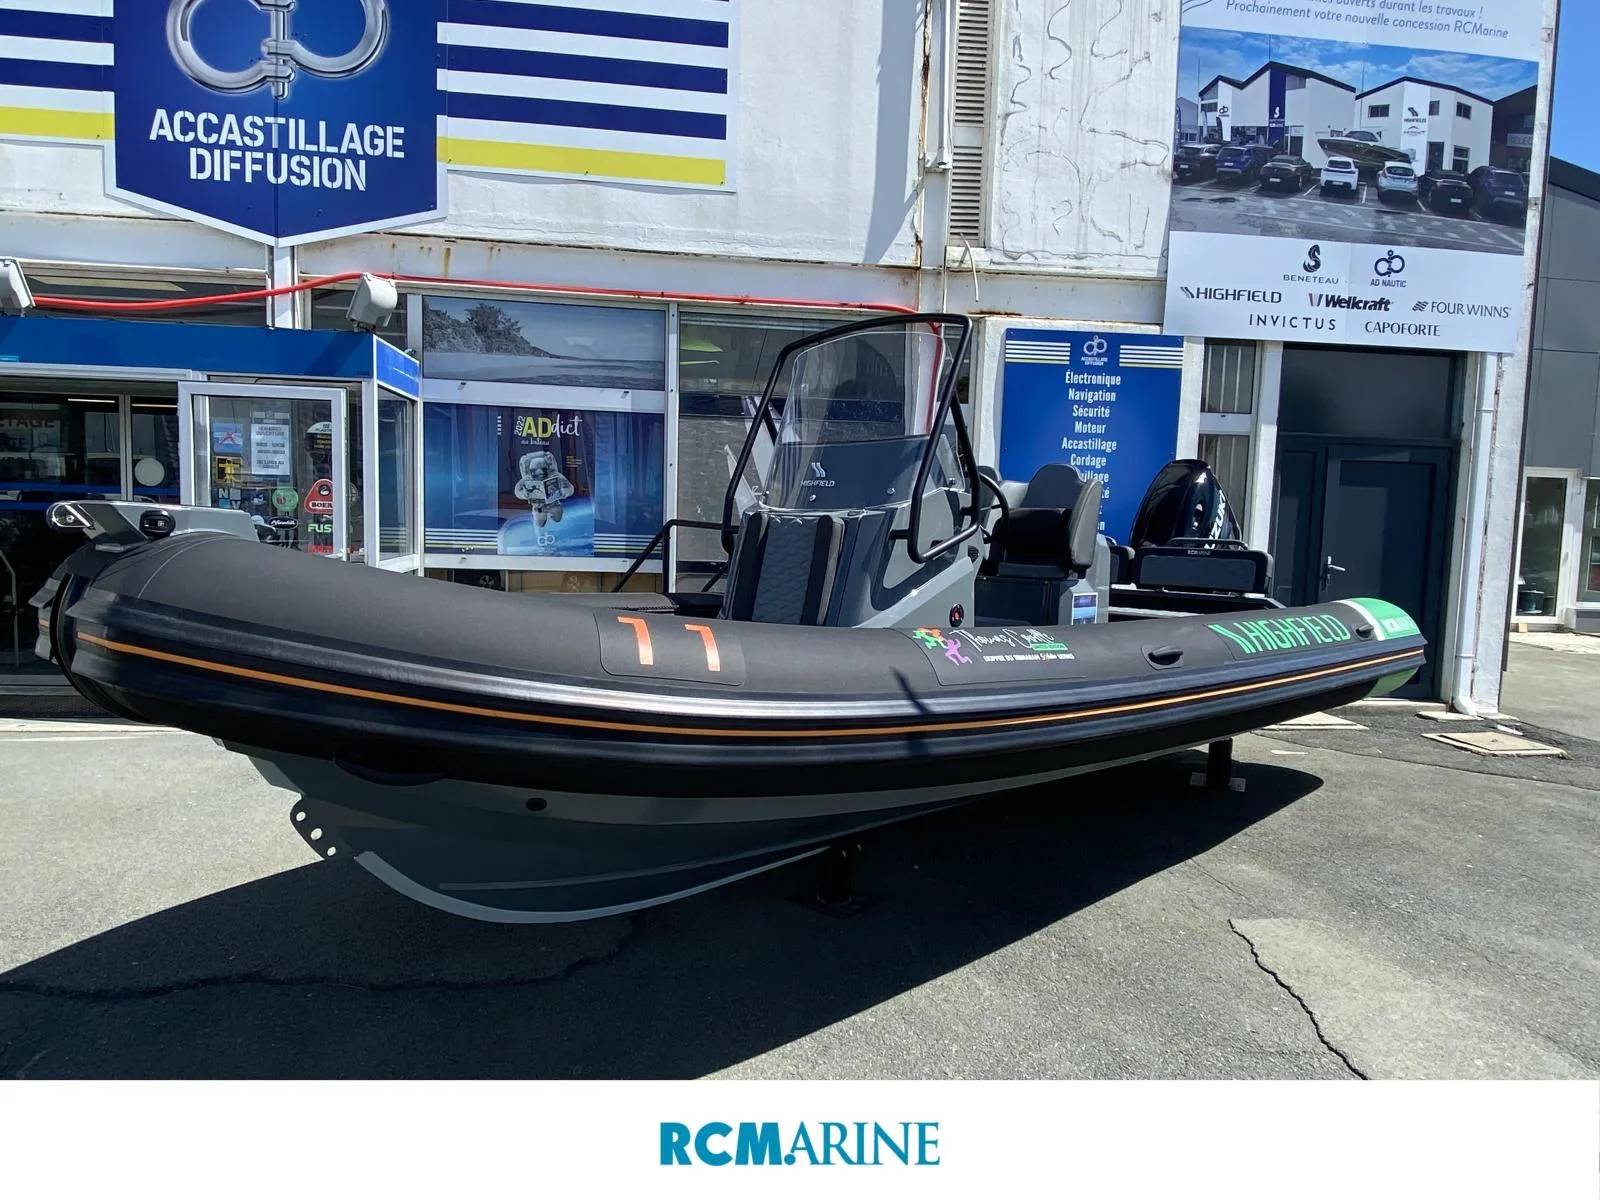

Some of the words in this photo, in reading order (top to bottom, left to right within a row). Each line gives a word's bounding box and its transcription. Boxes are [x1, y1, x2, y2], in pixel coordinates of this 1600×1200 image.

[1379, 0, 1415, 13] durant
[1418, 2, 1433, 13] les
[1436, 6, 1475, 18] travaux
[1226, 0, 1310, 17] Prochainement
[1314, 9, 1342, 21] votre
[1345, 13, 1389, 26] nouvelle
[1392, 18, 1450, 32] concession
[1453, 20, 1509, 38] RCMarine
[149, 108, 405, 159] ACCASTILLAGE
[189, 147, 366, 191] DIFFUSION
[1283, 274, 1339, 284] BENETEAU
[1370, 279, 1380, 287] AD
[1382, 279, 1407, 288] NAUTIC
[1196, 287, 1282, 304] HIGHFIELD
[1325, 294, 1391, 312] Wellcraft
[1431, 301, 1465, 315] FOUR
[1467, 304, 1509, 319] WINNS
[1249, 313, 1336, 331] INVICTUS
[1364, 321, 1441, 337] CAPOFORTE
[1065, 369, 1121, 387] Électronique
[1068, 388, 1116, 403] Navigation
[1072, 405, 1110, 418] Sécurité
[1074, 421, 1106, 434] Moteur
[1061, 437, 1117, 452] Accastillage
[1070, 453, 1106, 469] Cordage
[1081, 470, 1109, 484] illage
[307, 524, 333, 533] FUS
[1233, 614, 1351, 652] HIGHFIELD
